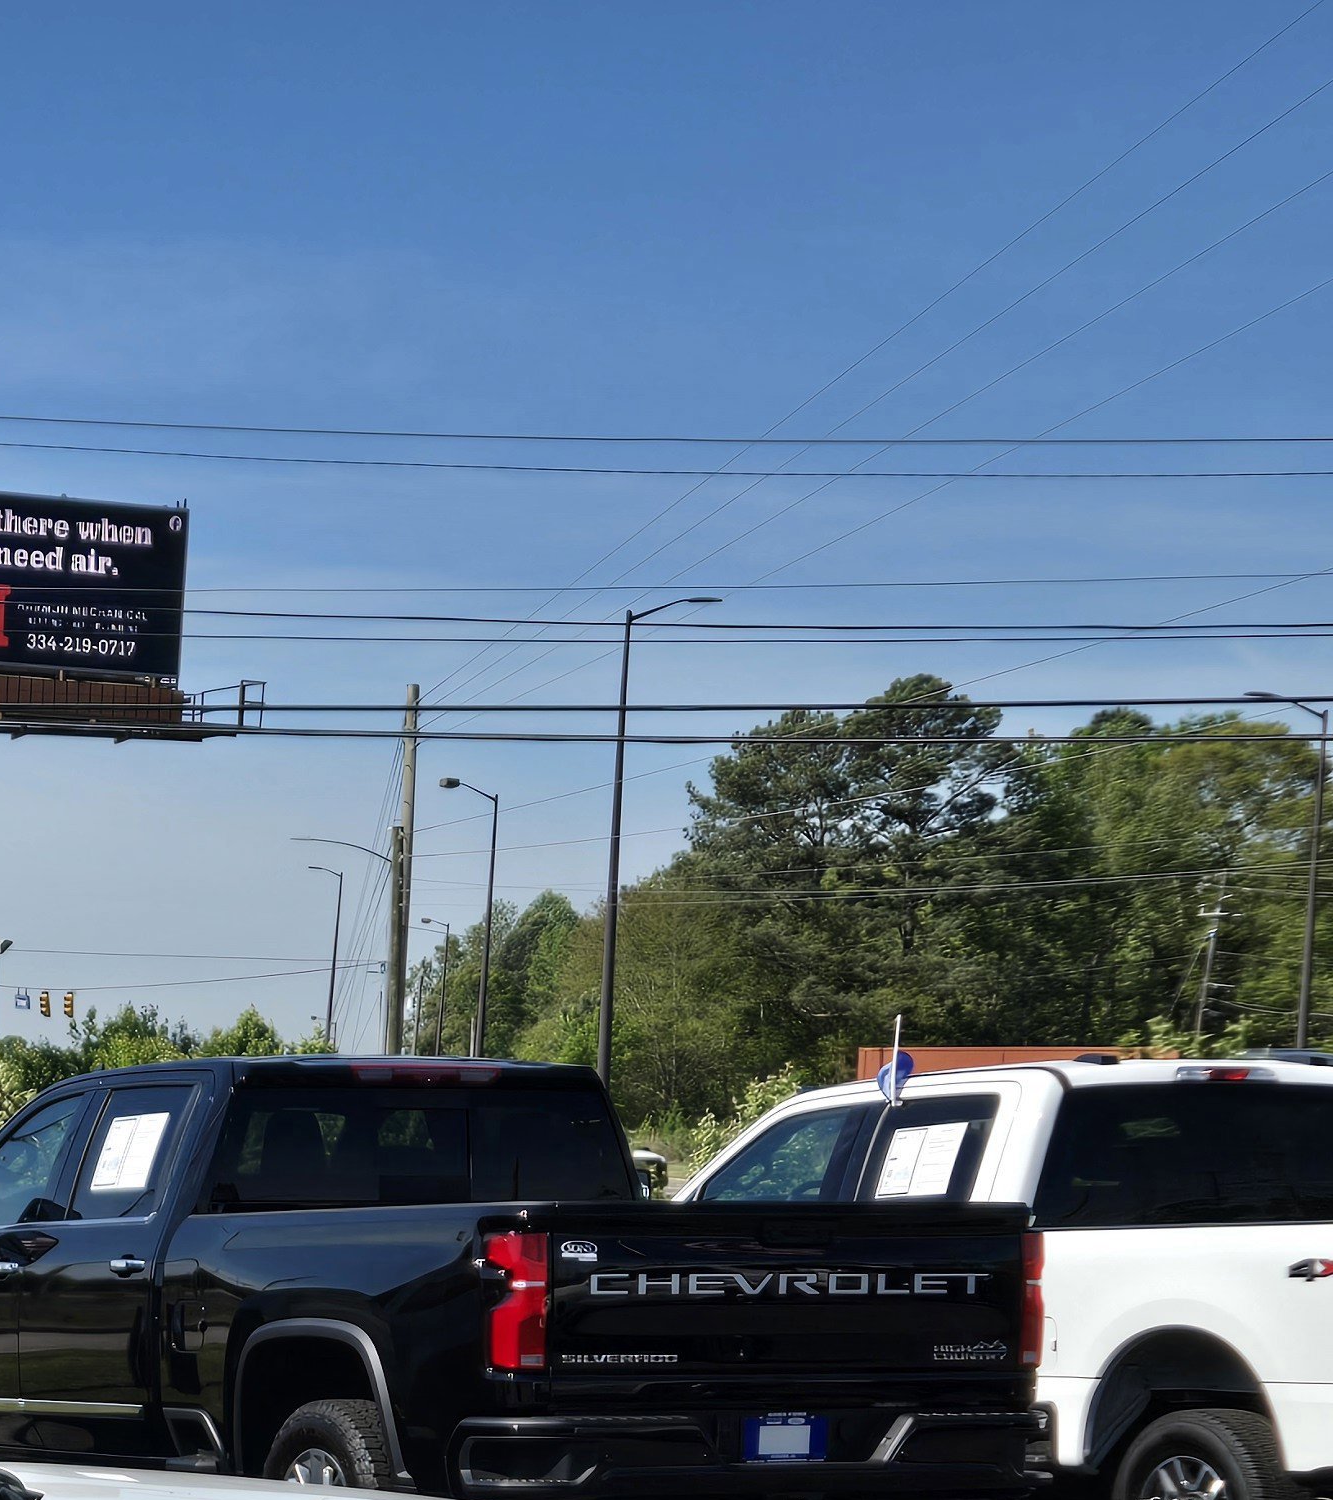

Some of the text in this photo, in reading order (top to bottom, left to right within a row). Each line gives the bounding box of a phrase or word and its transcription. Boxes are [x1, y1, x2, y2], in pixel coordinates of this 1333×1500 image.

[77, 518, 152, 545] when
[71, 549, 119, 576] air.
[26, 633, 136, 656] 334-219-0717
[590, 1273, 989, 1296] CHEVROLET
[562, 1354, 678, 1364] SILVERADO
